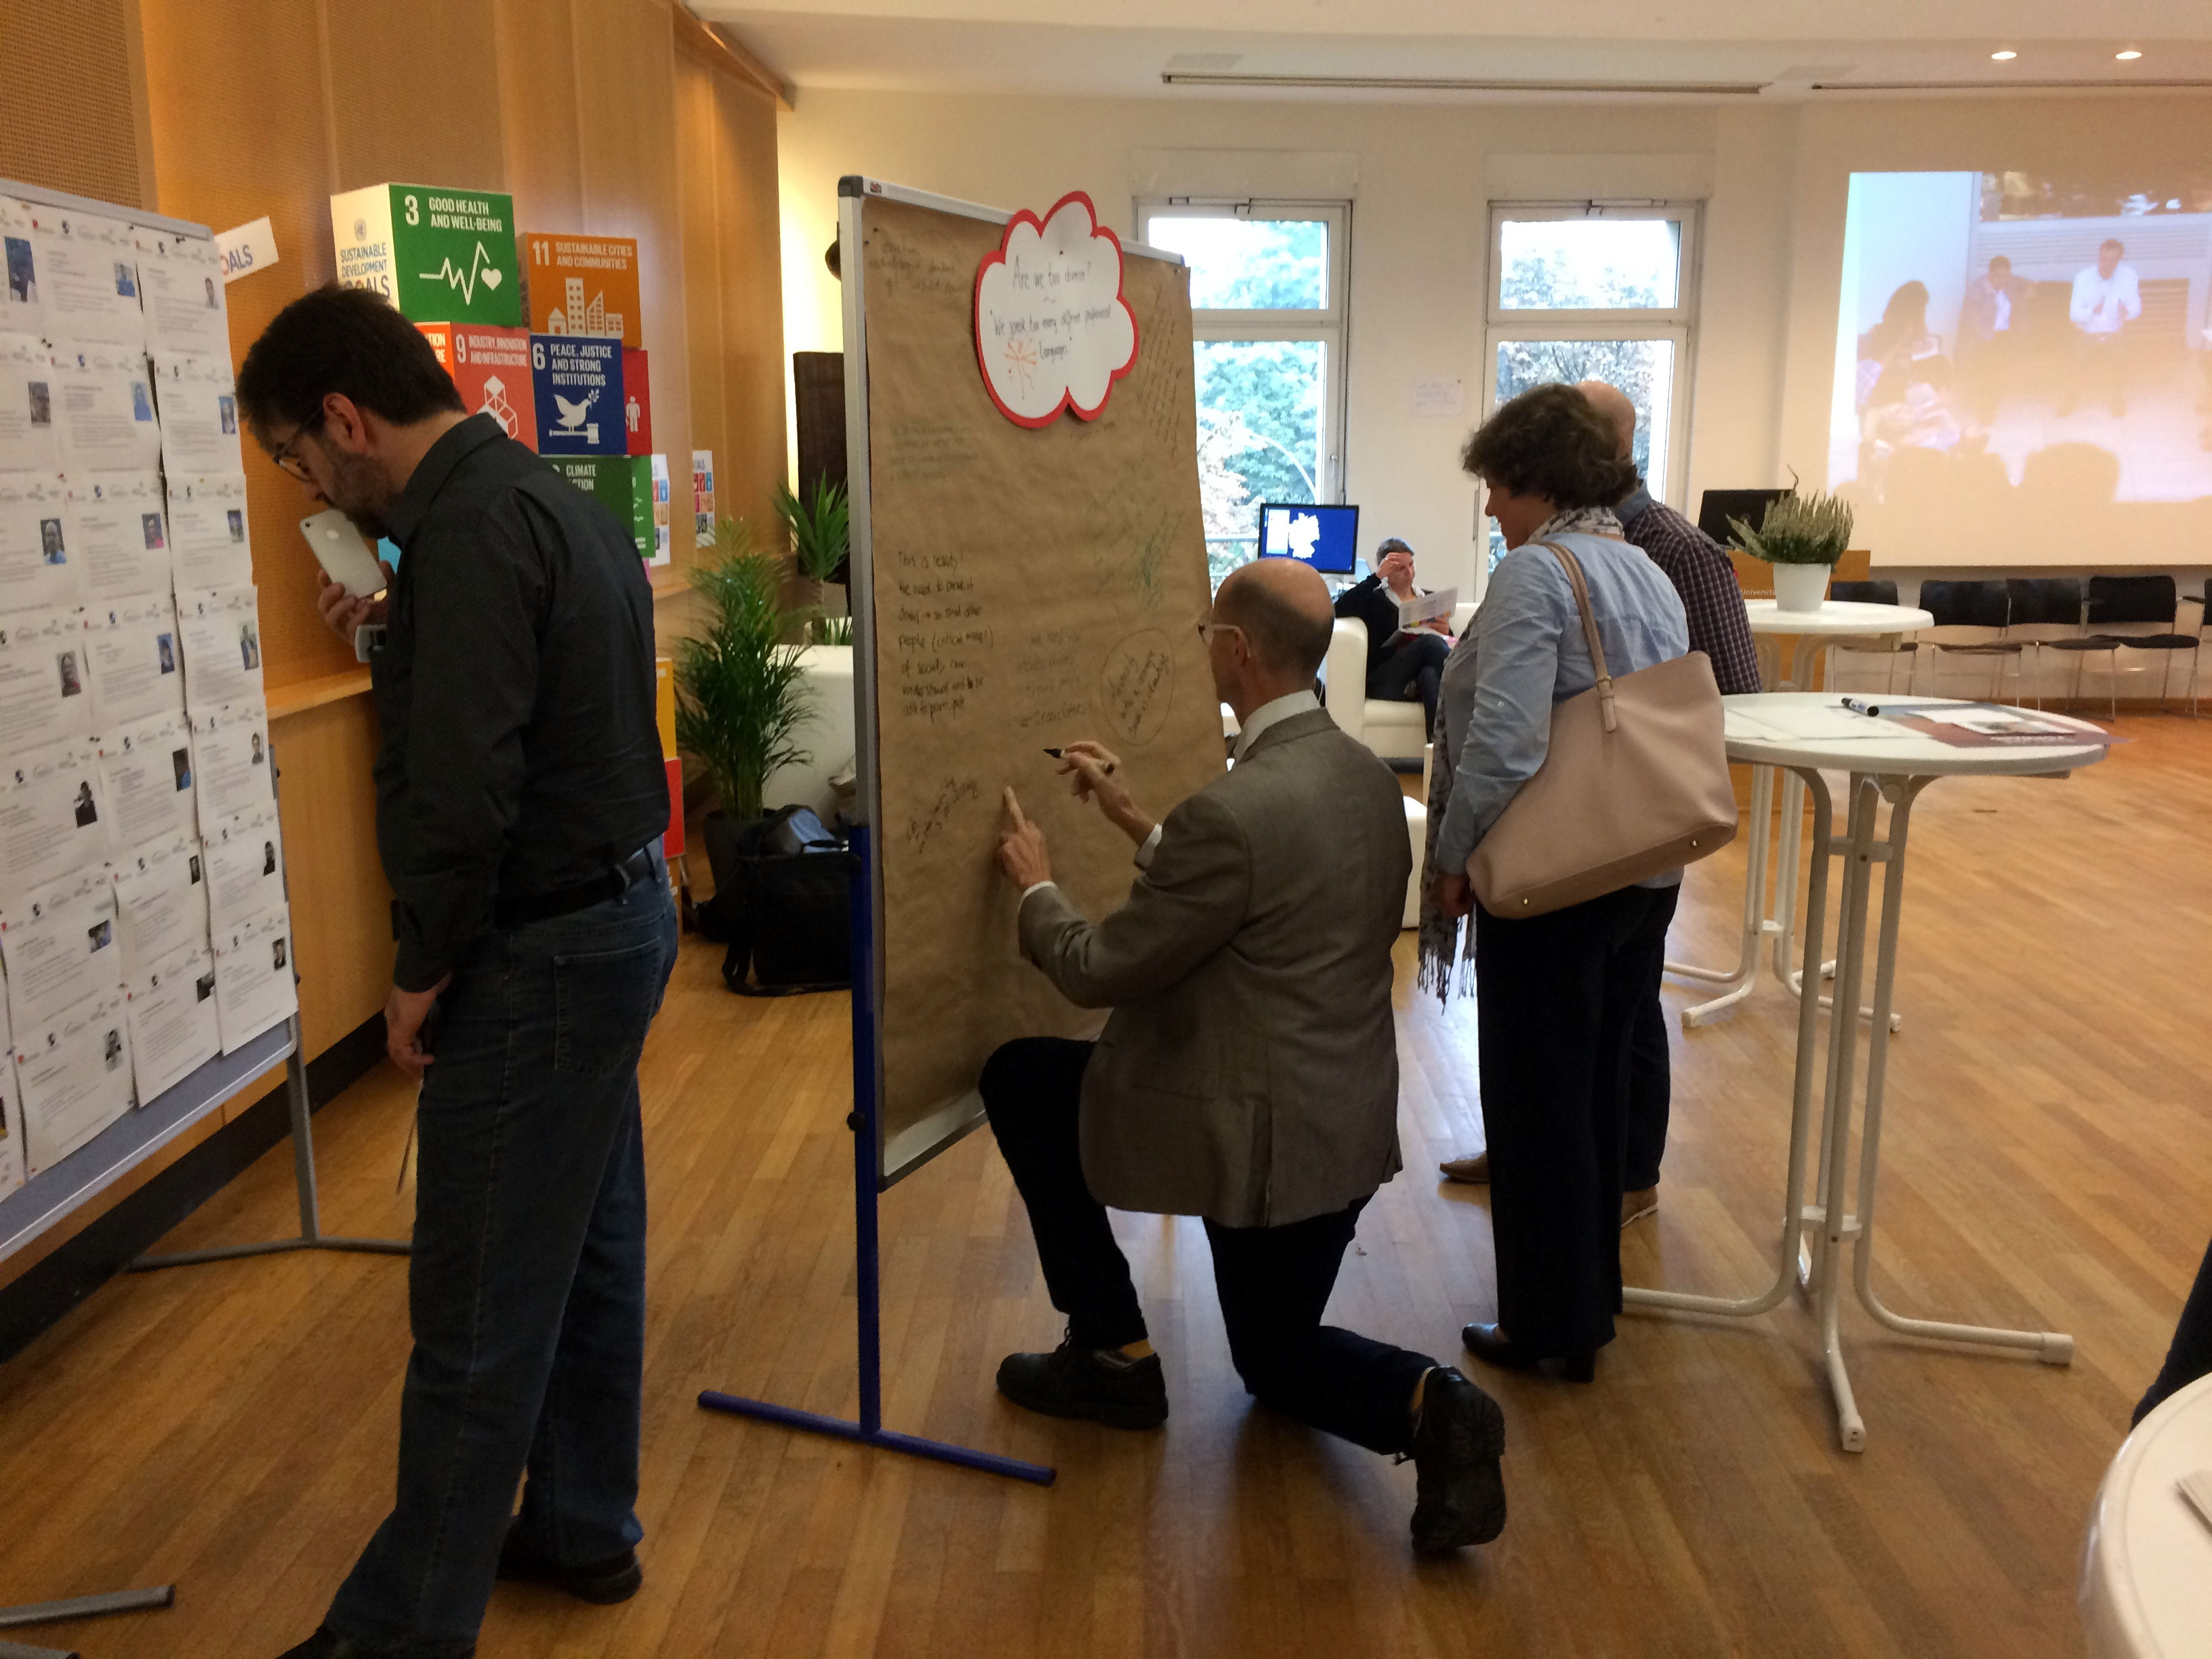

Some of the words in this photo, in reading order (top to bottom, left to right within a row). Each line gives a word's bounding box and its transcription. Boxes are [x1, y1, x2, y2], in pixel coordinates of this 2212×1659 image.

[405, 194, 419, 226] 3
[428, 197, 455, 213] GOOD
[456, 199, 489, 215] HEALTH
[430, 213, 450, 228] AND
[451, 215, 502, 232] WELL-BEING
[340, 242, 386, 263] SUSTAINABLE
[533, 240, 550, 266] 11
[556, 241, 608, 255] SUSTAINABLE
[608, 244, 632, 257] CITIES
[342, 260, 387, 278] DEVELOPMENT
[557, 255, 573, 267] AND
[574, 256, 628, 270] COMMUNITIES
[1013, 255, 1029, 290] Are
[1034, 272, 1044, 289] we
[1048, 262, 1060, 287] too
[1009, 316, 1025, 339] speak
[1030, 315, 1039, 332] too
[1042, 318, 1057, 334] many
[455, 333, 466, 363] 9
[550, 344, 579, 357] PEACE,
[580, 345, 612, 359] JUSTICE
[552, 359, 569, 371] AND
[570, 359, 602, 372] STRONG
[552, 372, 606, 387] INSTITUTIONS
[566, 464, 596, 478] CLIMATE
[898, 551, 916, 567] This
[922, 556, 928, 569] is
[899, 632, 925, 654] people
